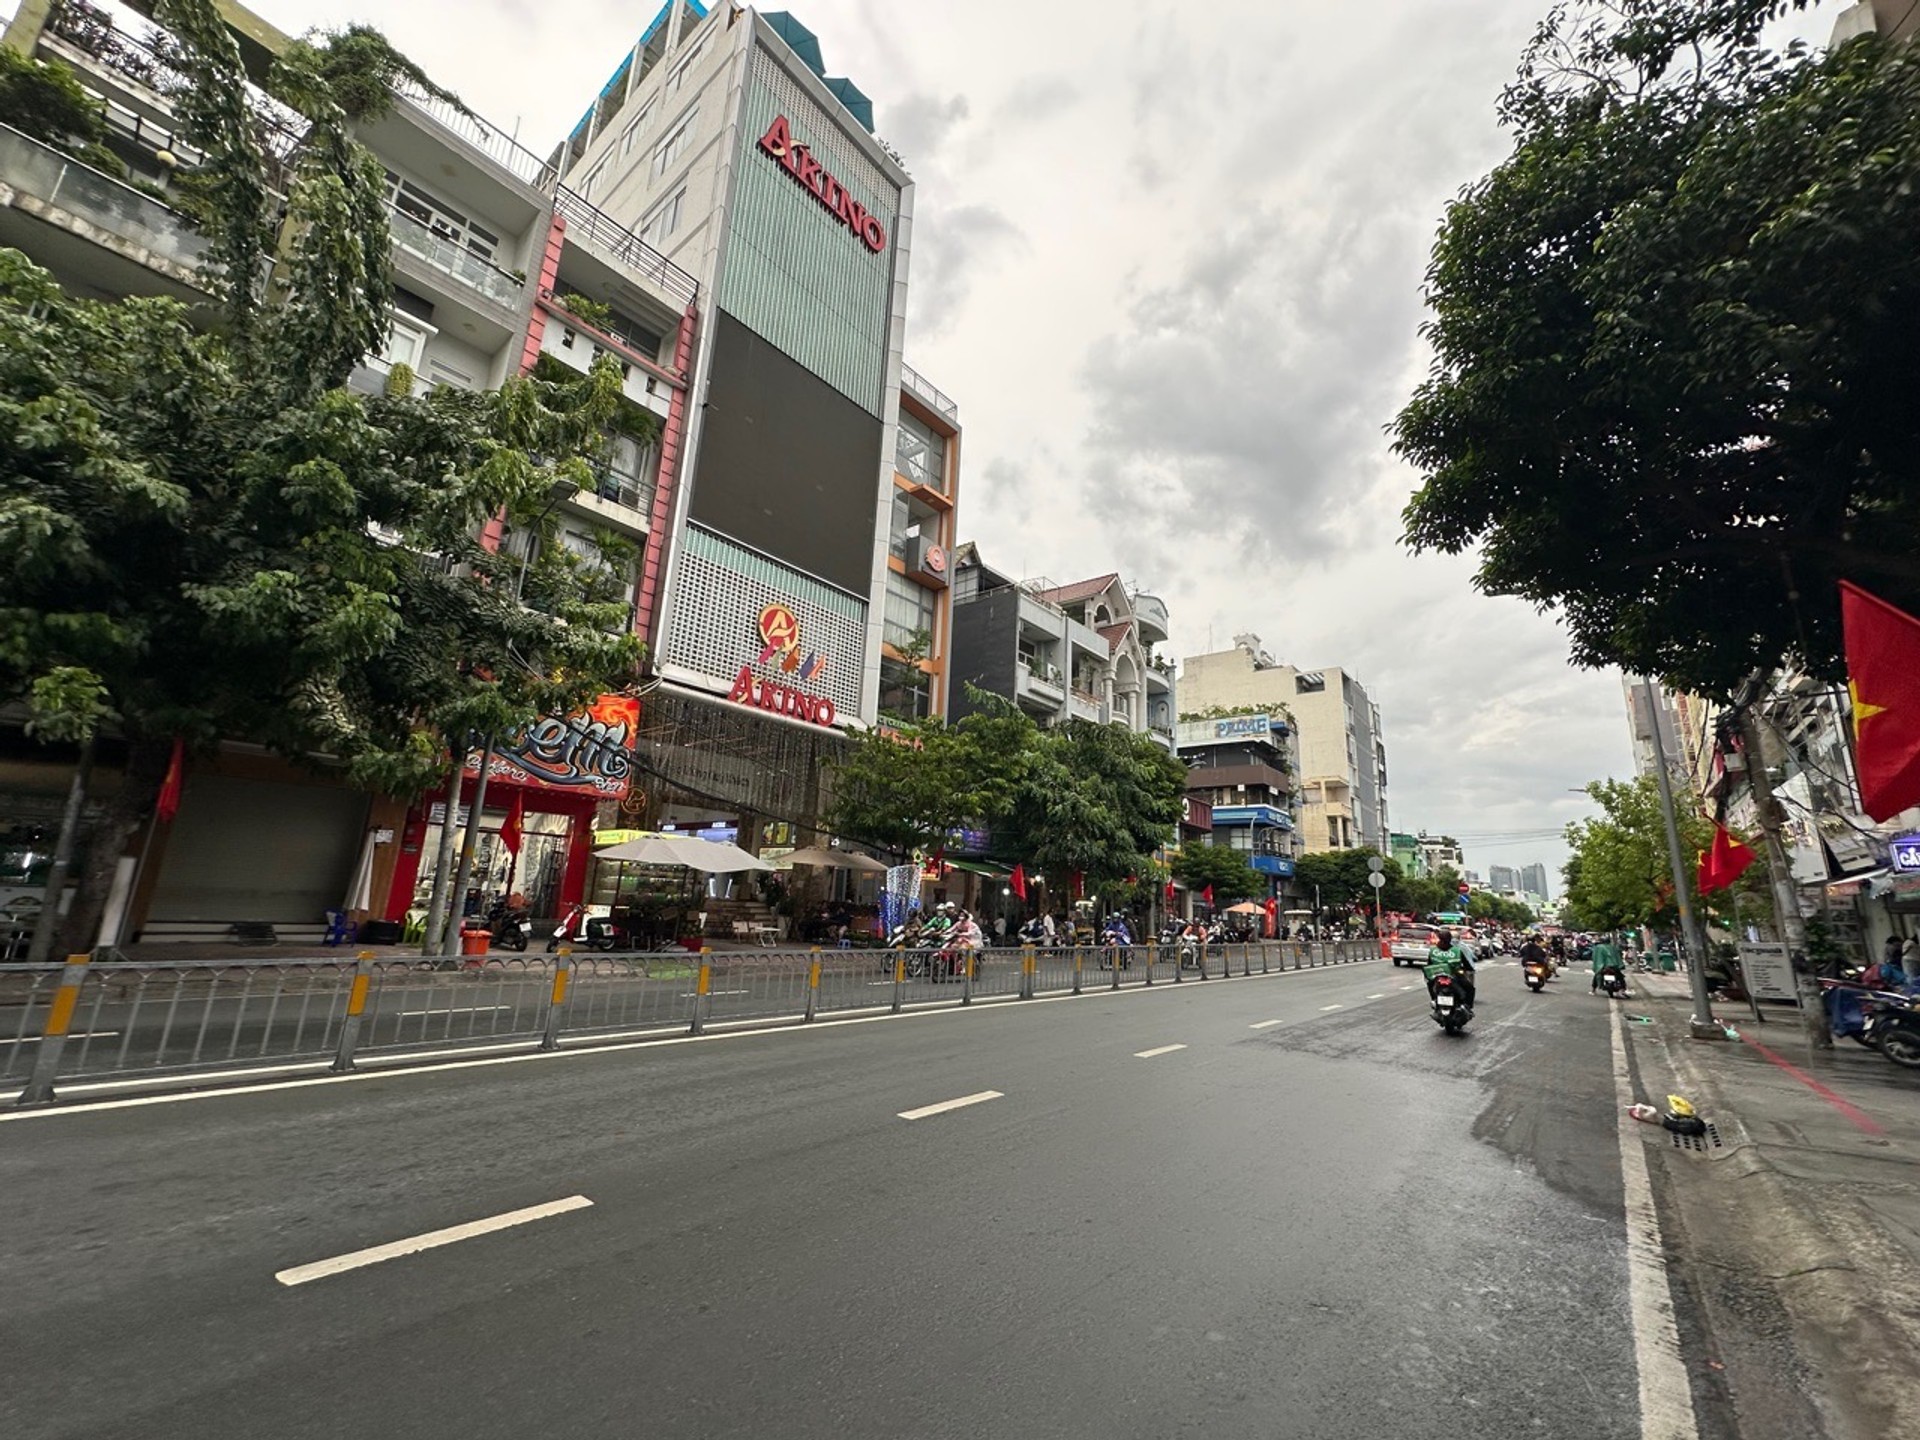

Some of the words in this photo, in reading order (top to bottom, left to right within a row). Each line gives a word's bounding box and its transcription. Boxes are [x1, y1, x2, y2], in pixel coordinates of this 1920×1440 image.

[757, 114, 886, 252] AKINO
[727, 665, 835, 726] AKINO
[1216, 718, 1267, 737] PRIME
[1432, 950, 1456, 958] Grab
